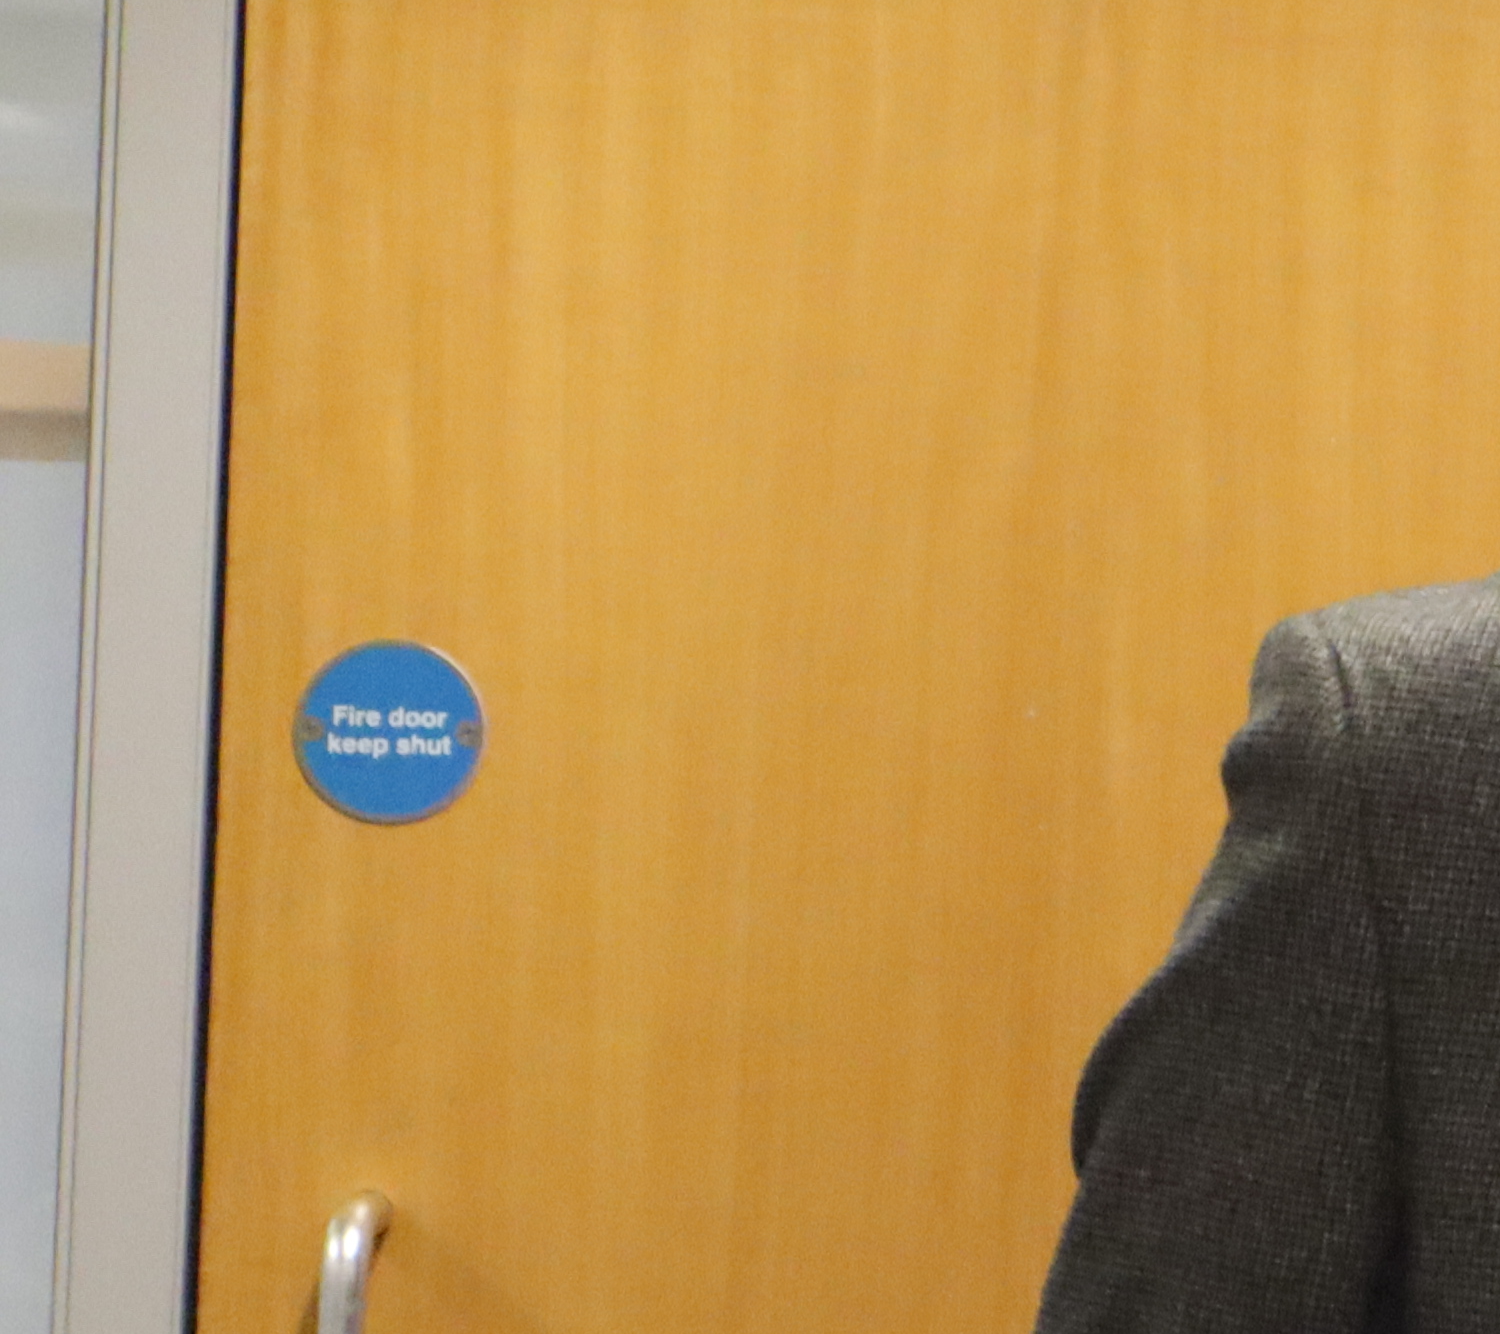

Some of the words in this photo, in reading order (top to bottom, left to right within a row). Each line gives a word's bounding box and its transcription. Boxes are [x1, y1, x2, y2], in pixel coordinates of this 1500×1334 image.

[333, 705, 381, 727] Fire
[388, 707, 448, 729] door
[327, 732, 389, 759] keep
[396, 734, 451, 755] shut
